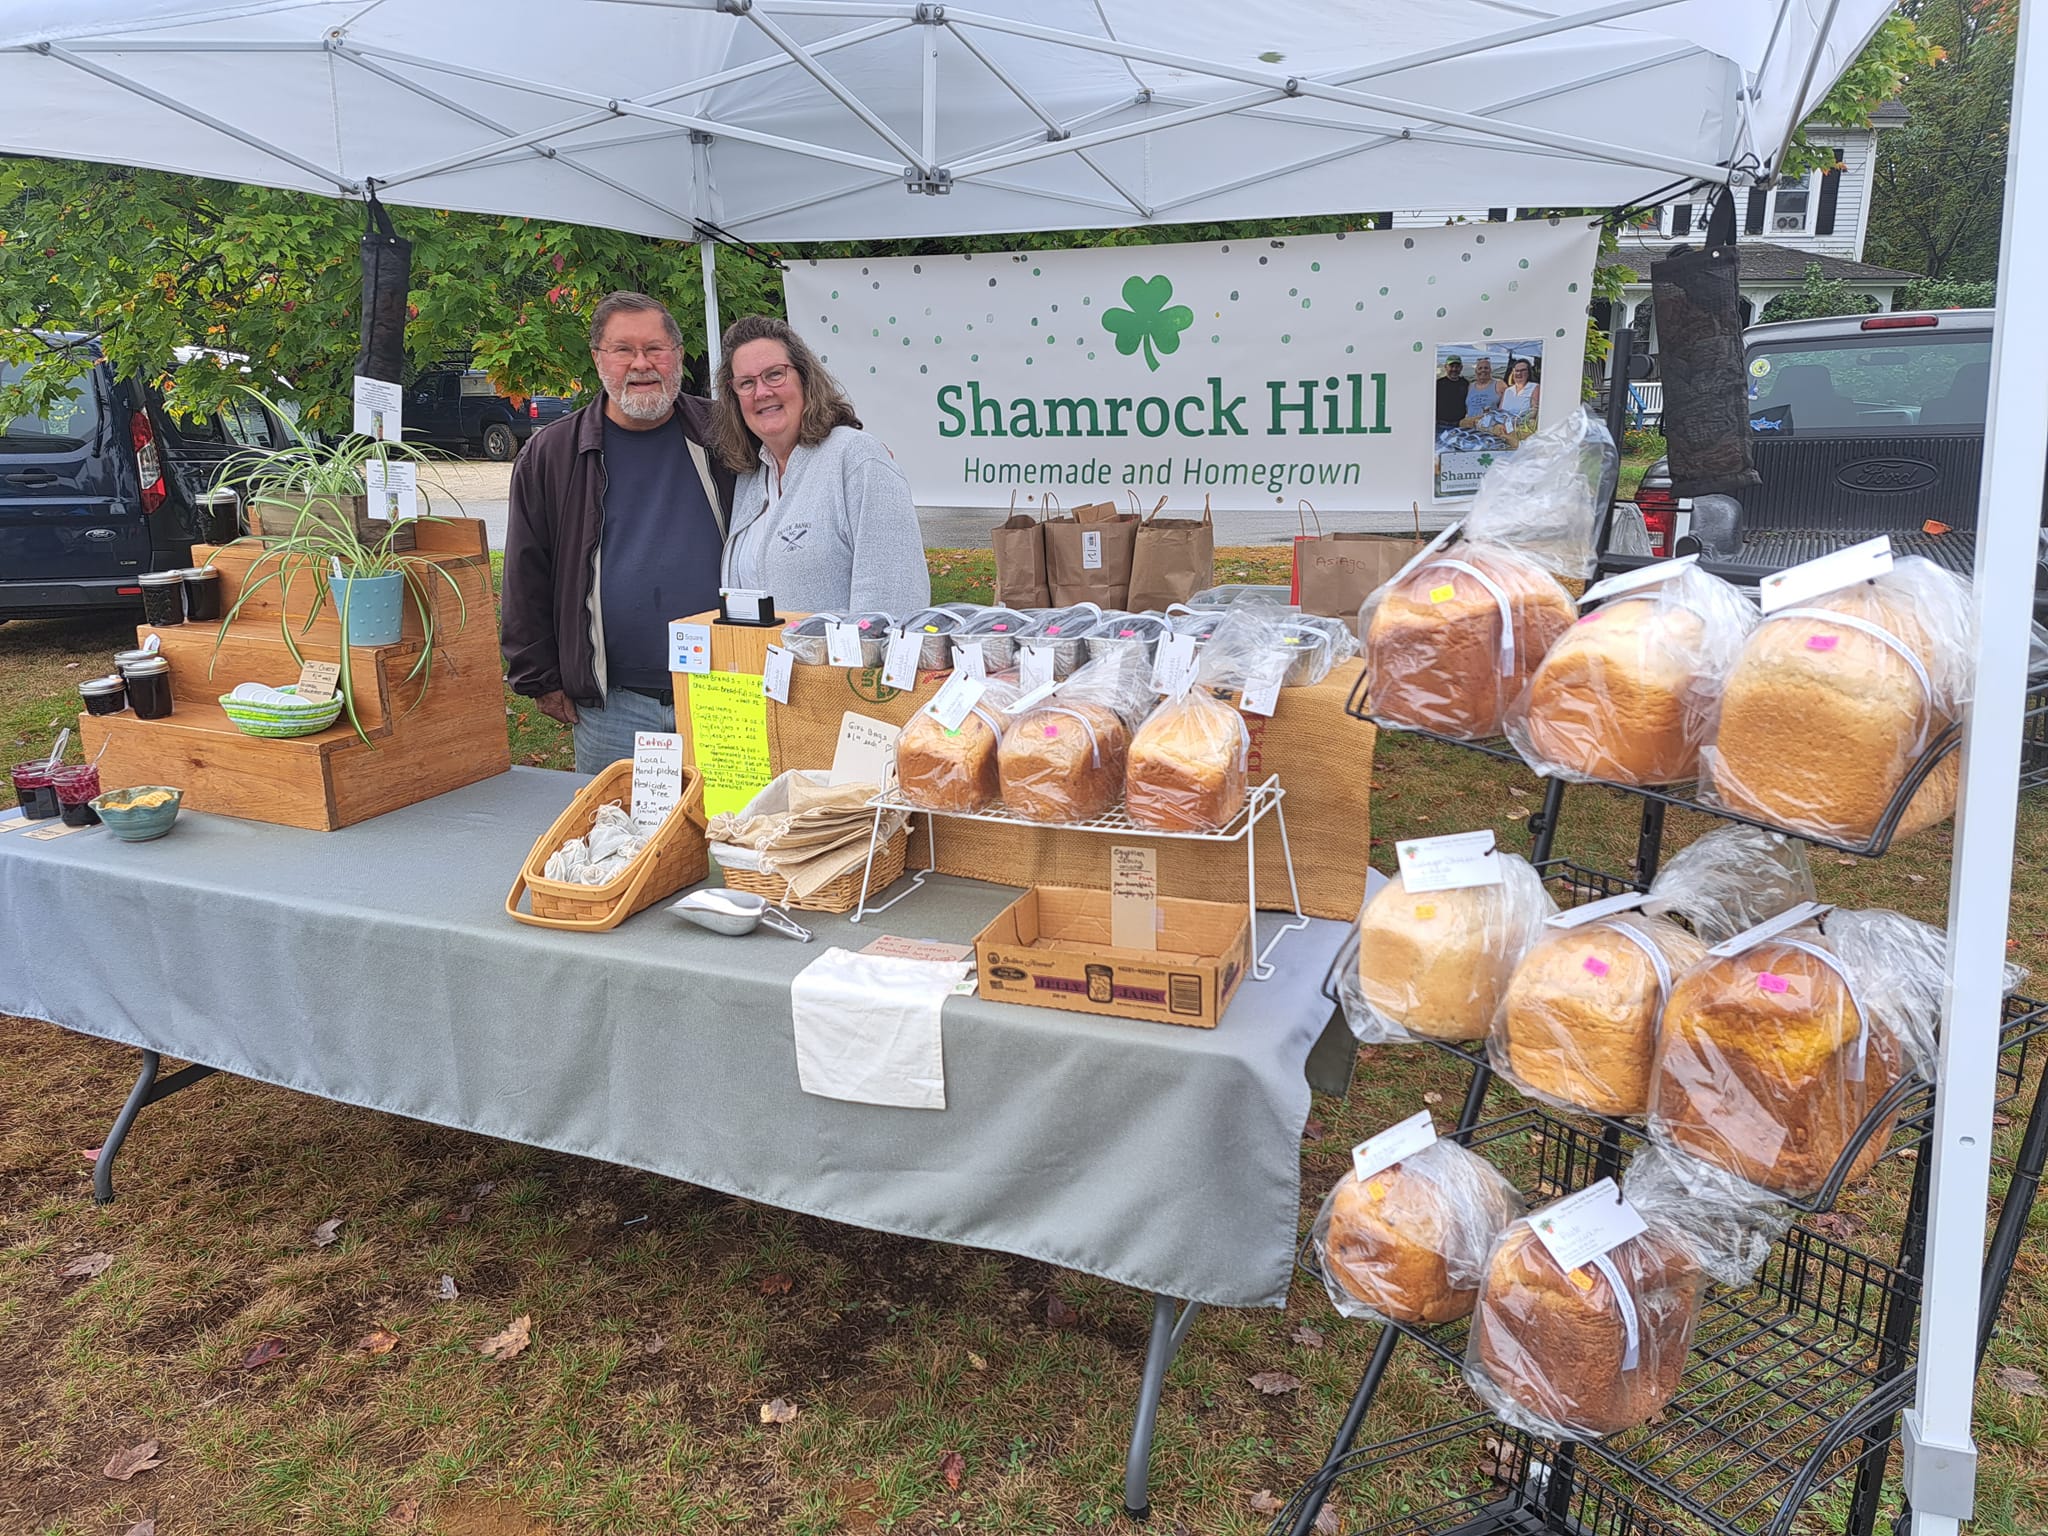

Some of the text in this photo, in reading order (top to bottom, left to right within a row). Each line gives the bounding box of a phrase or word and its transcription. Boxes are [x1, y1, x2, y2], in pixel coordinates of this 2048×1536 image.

[936, 373, 1392, 438] Shamrock Hill
[964, 457, 1361, 493] Homemade and Homegrown
[1856, 462, 1918, 485] Ford
[684, 633, 704, 641] Square
[638, 736, 673, 750] Catnip
[1038, 978, 1082, 992] JELLY
[1119, 988, 1161, 1001] JARS
